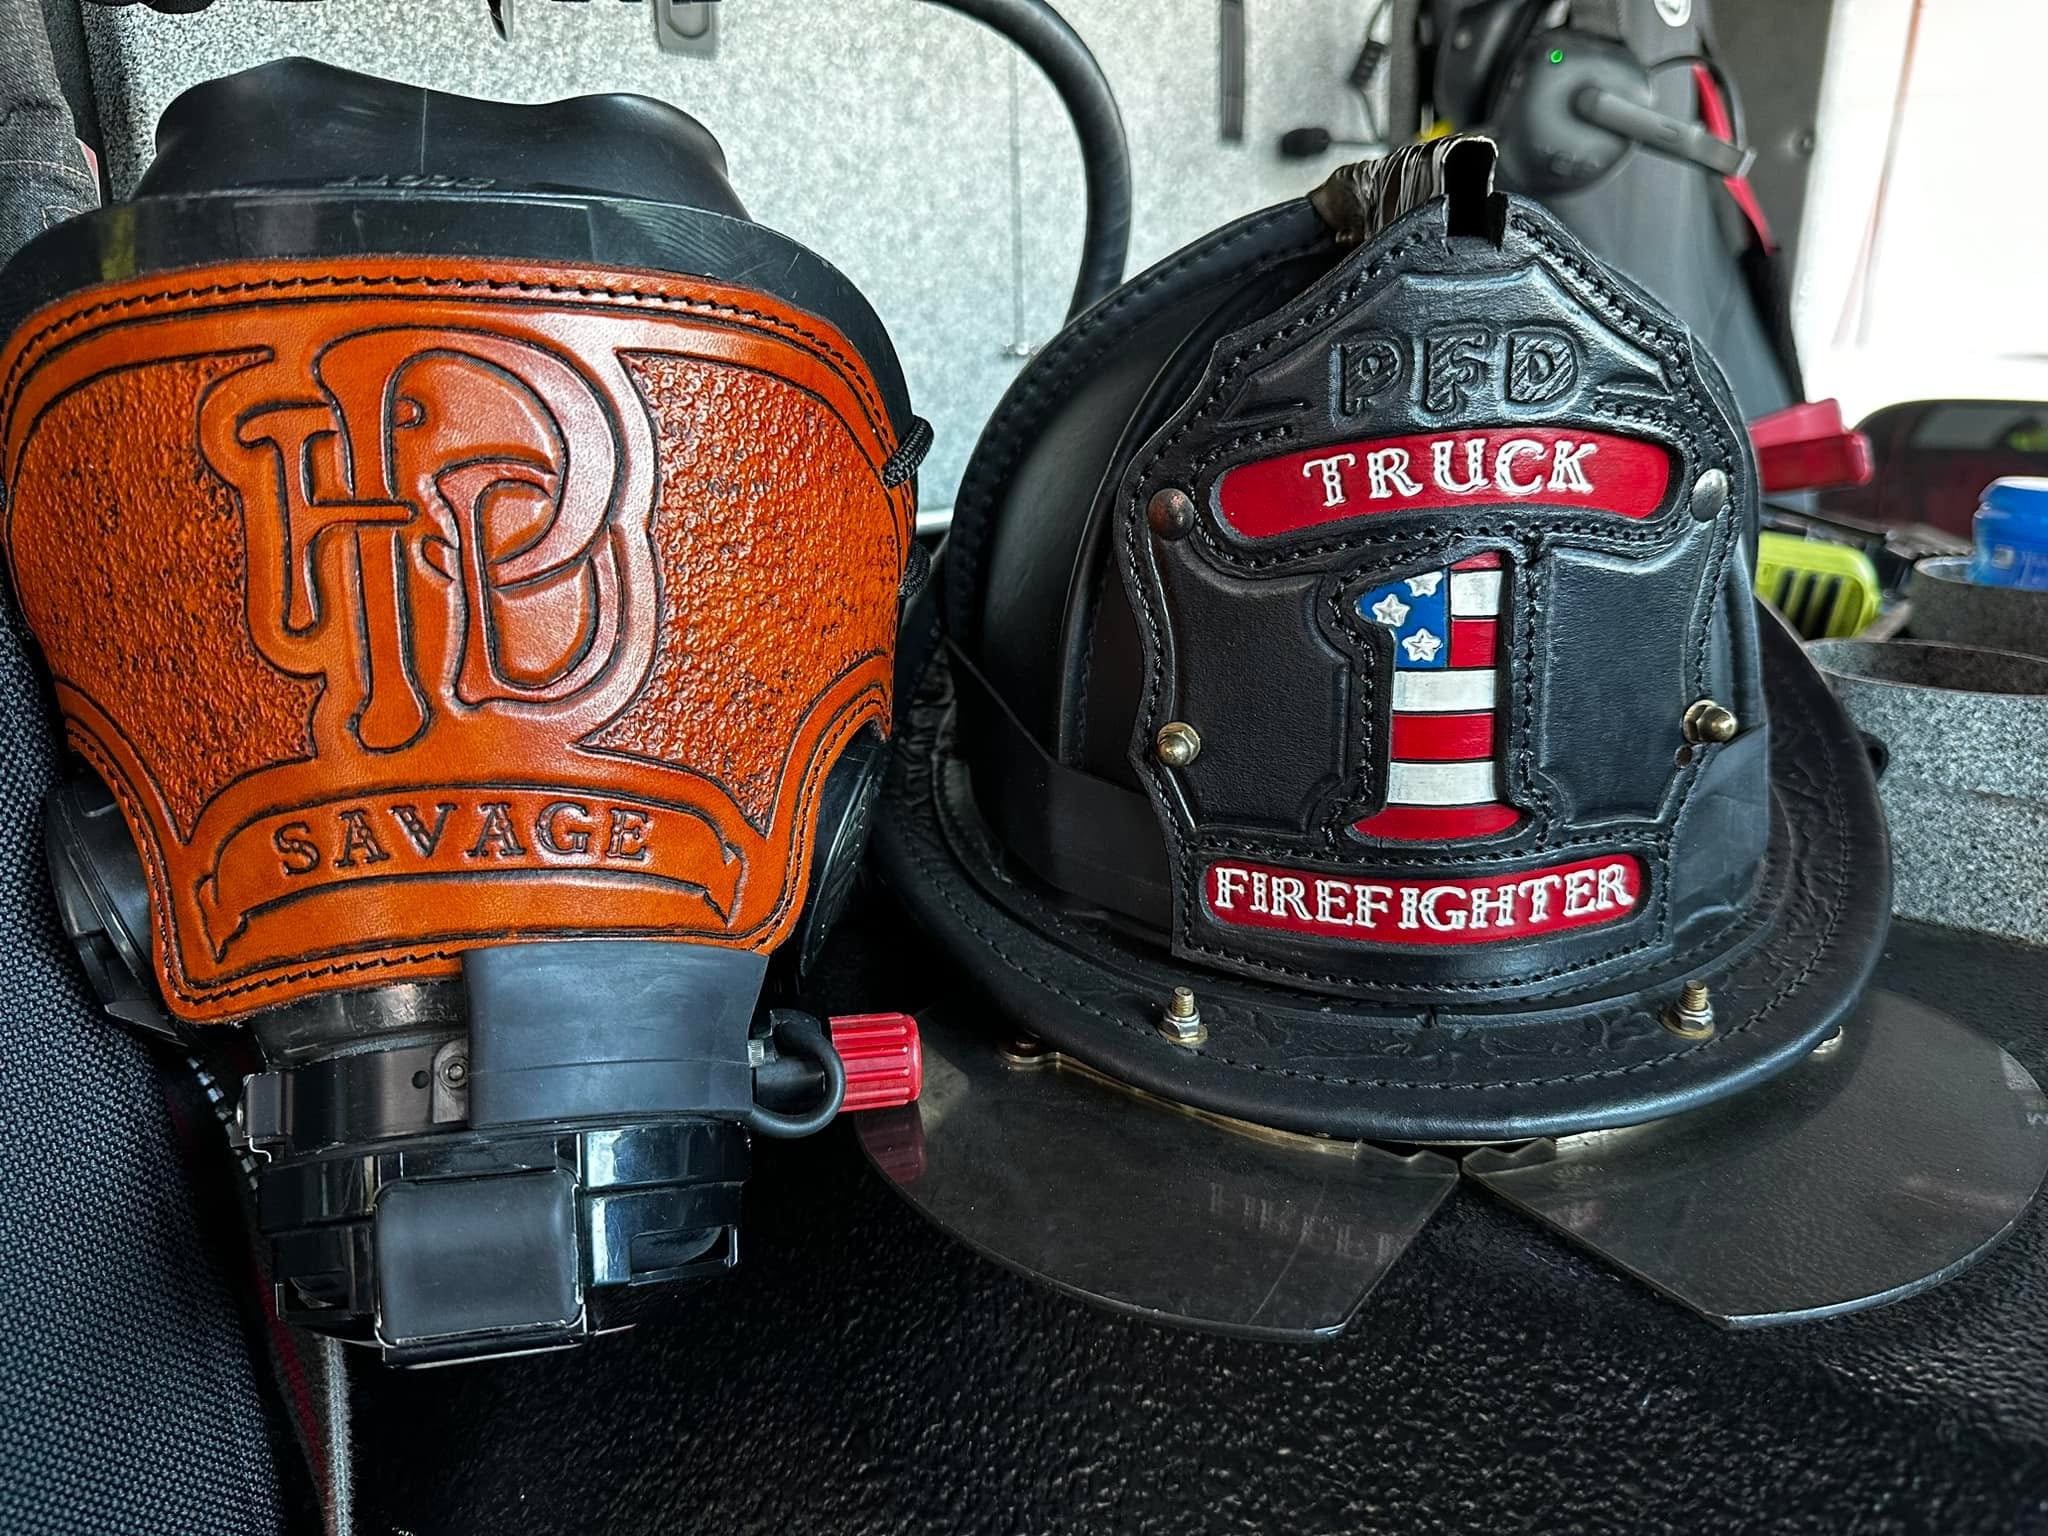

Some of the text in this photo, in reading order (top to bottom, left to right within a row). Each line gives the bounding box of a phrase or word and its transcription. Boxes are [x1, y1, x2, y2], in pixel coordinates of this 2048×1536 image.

[1331, 321, 1581, 424] PFD
[1302, 437, 1599, 508] TRUCK
[1351, 551, 1524, 841] 1
[271, 801, 651, 875] SAVAGE
[1213, 863, 1636, 932] FIREFIGHTER
